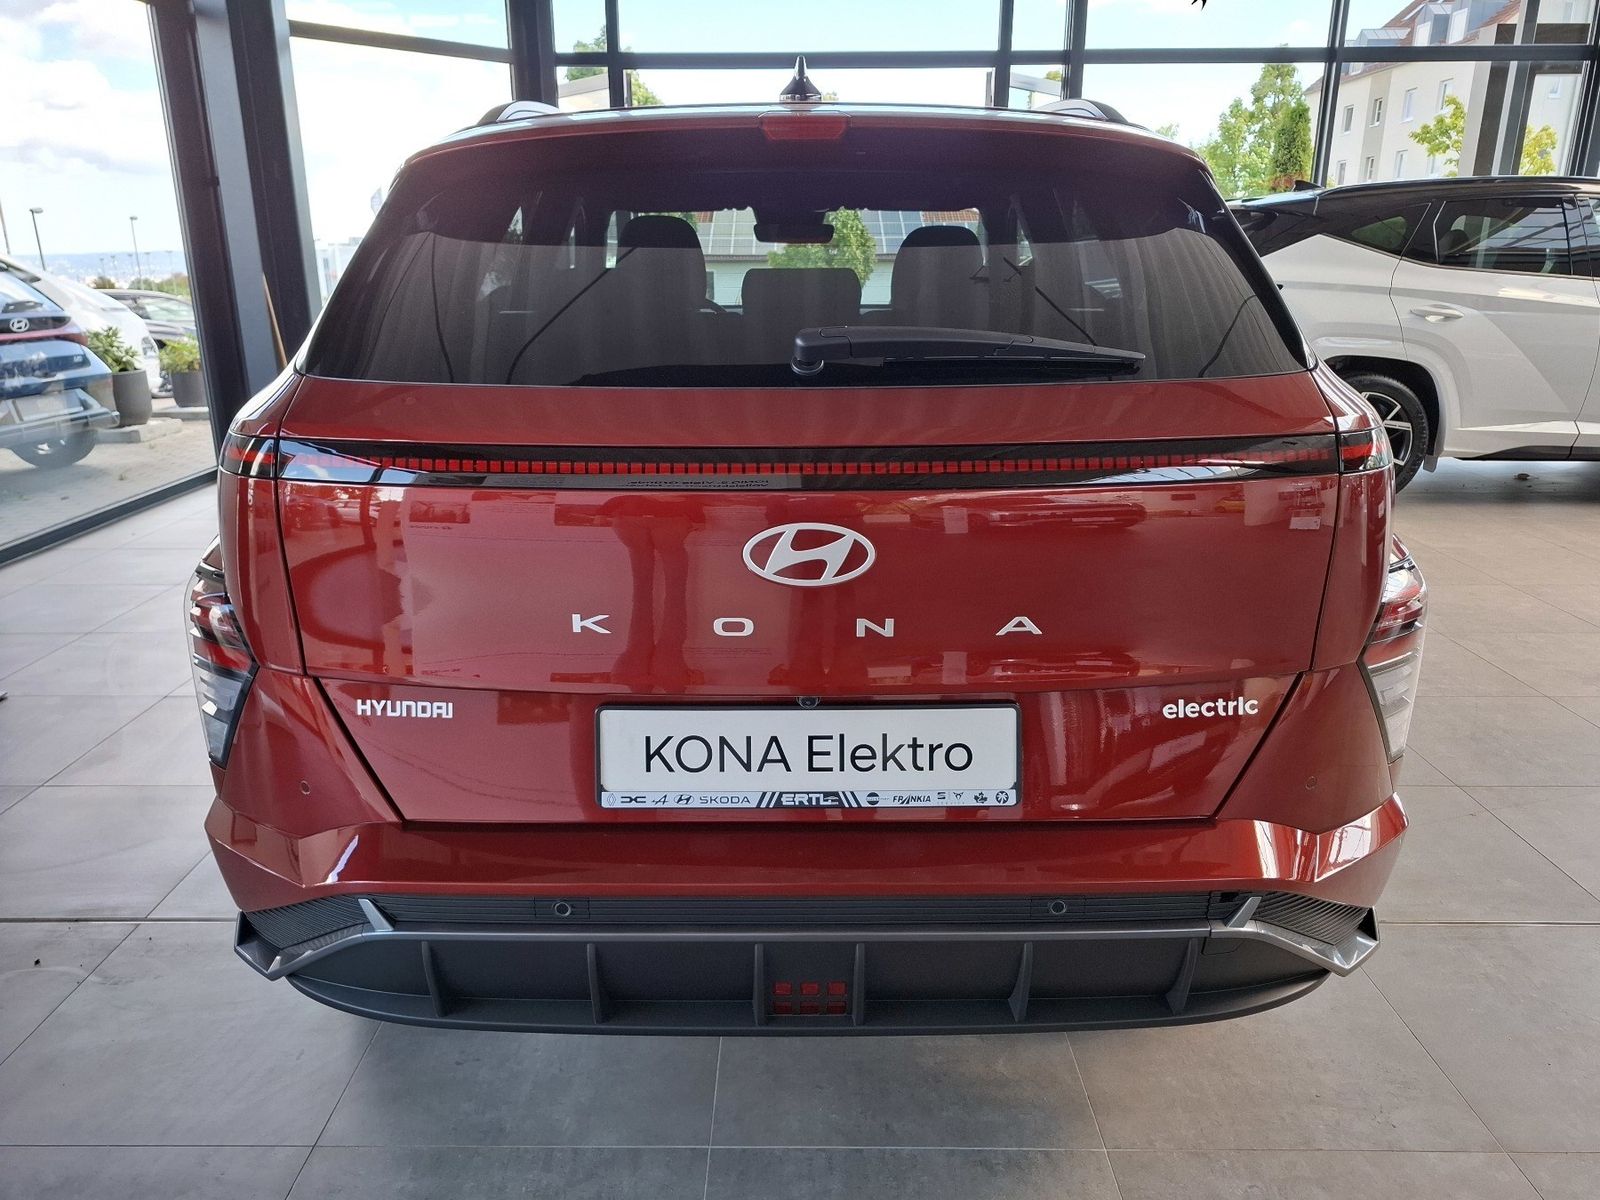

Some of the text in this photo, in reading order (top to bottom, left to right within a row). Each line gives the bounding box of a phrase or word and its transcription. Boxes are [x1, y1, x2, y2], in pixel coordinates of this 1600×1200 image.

[572, 613, 1042, 637] KONA
[357, 699, 453, 718] HYUNDAI
[1162, 696, 1259, 719] electric
[645, 733, 973, 773] KONA Elektro
